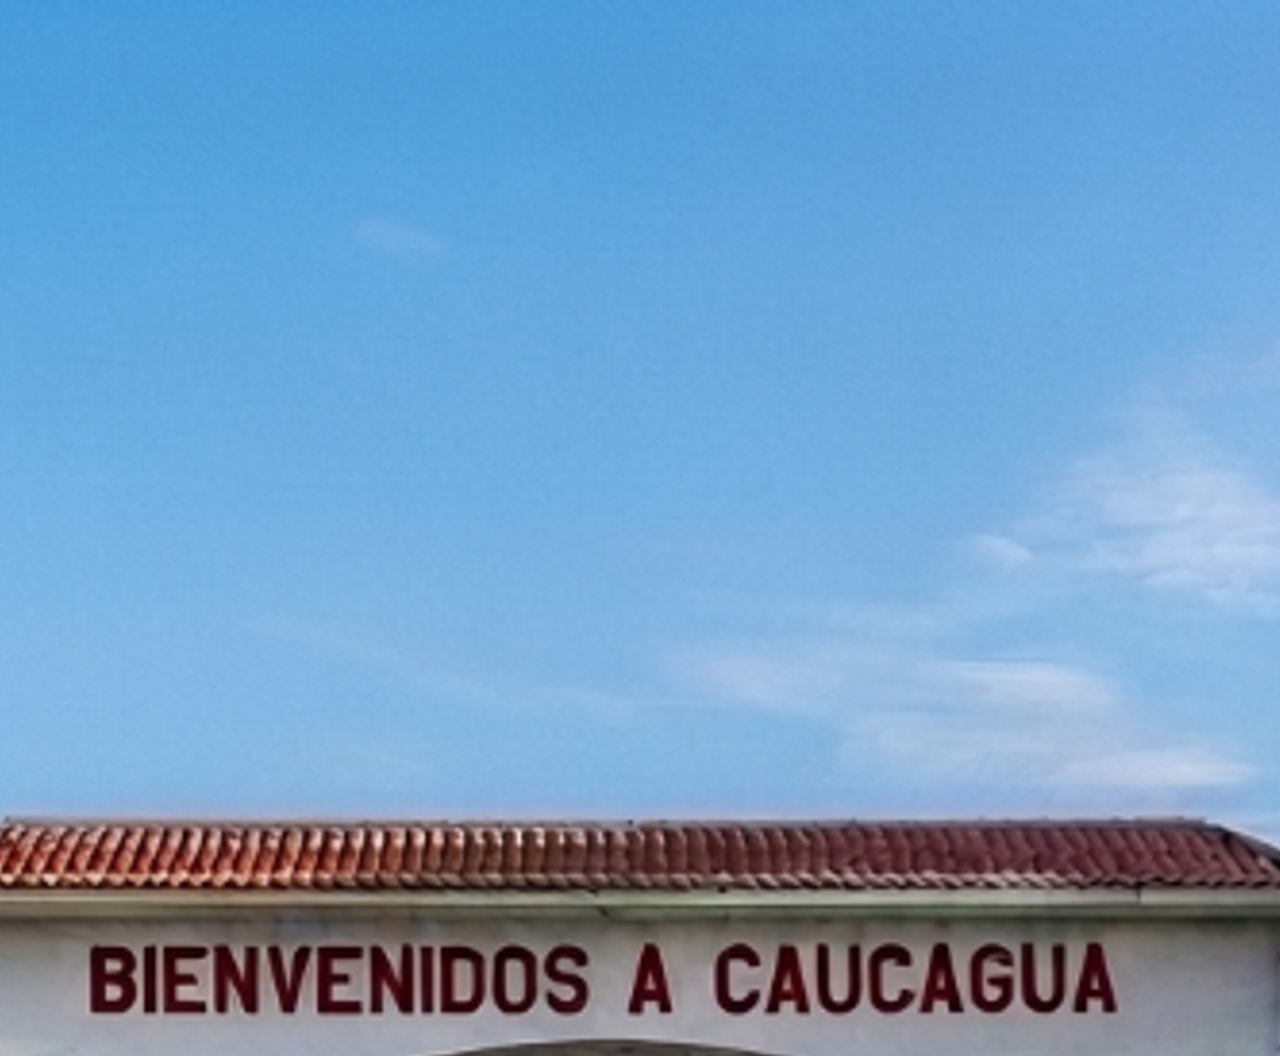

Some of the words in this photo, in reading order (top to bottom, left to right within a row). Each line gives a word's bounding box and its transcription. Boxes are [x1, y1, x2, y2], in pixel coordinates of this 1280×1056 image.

[89, 943, 590, 1015] BIENVENIDOS
[628, 943, 673, 1014] A
[713, 942, 1117, 1015] CAUCAGUA
